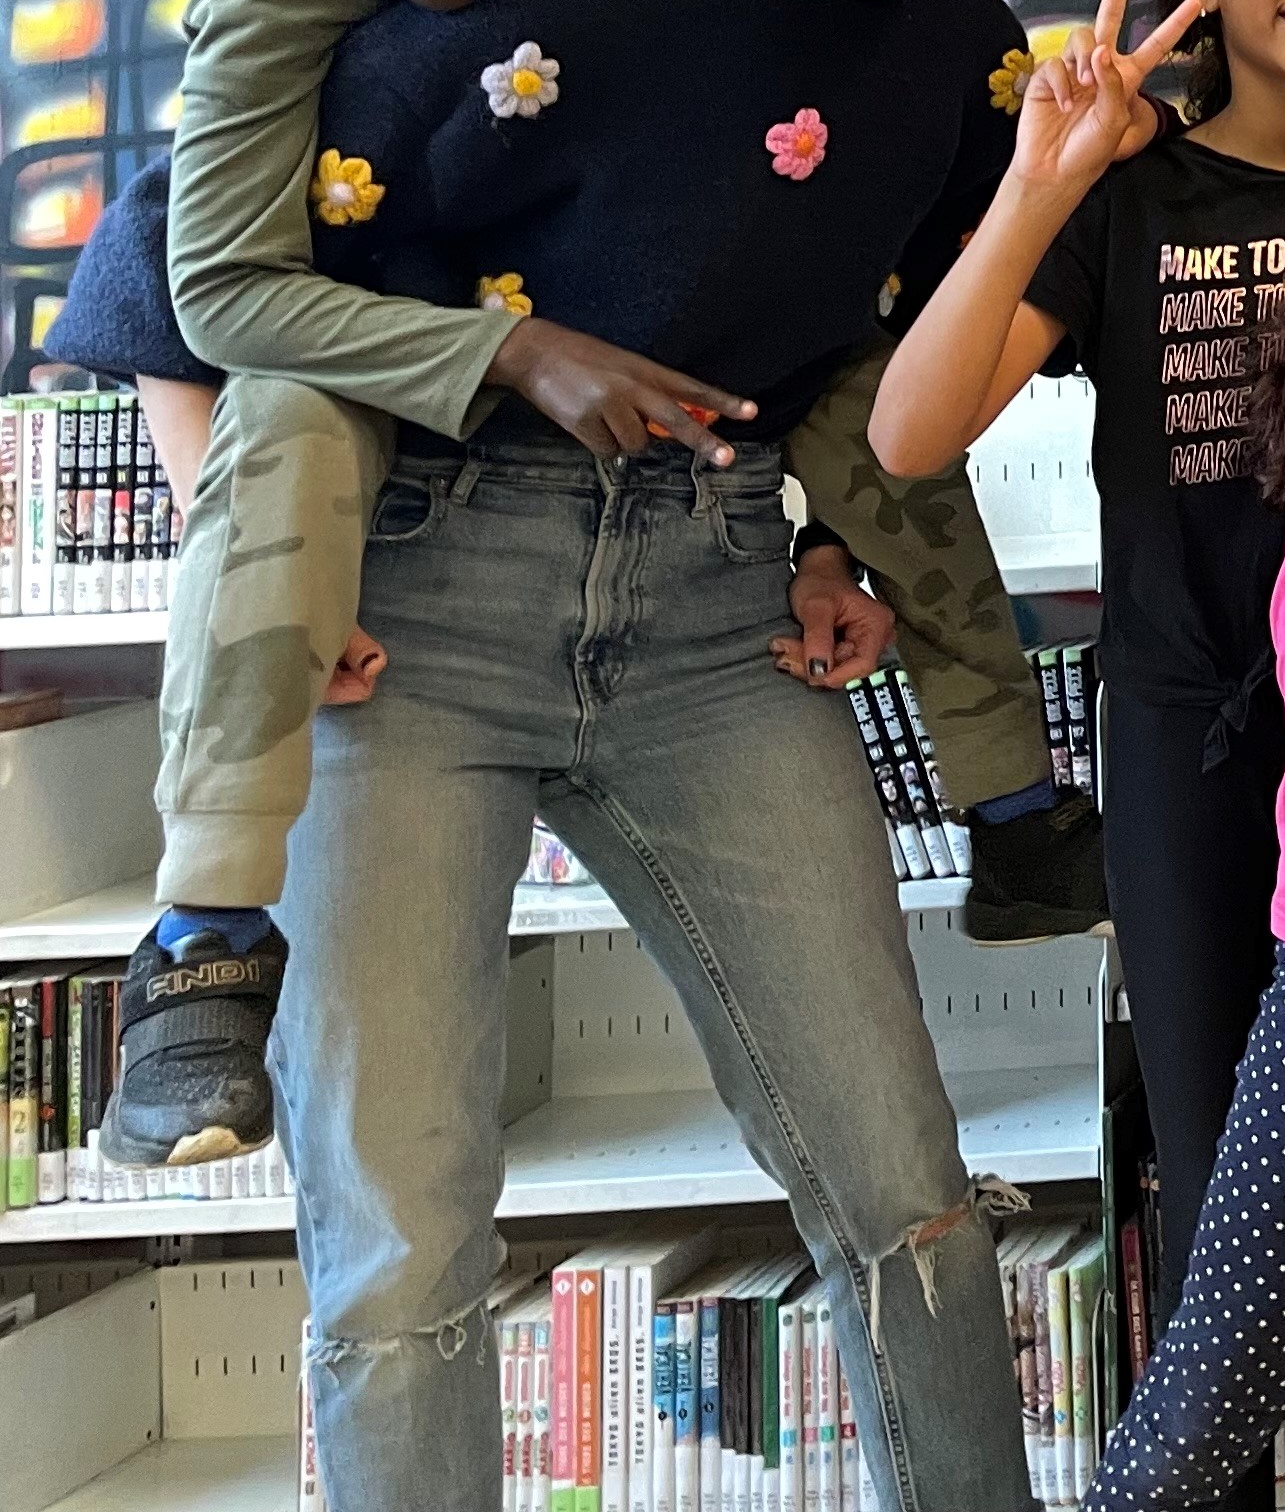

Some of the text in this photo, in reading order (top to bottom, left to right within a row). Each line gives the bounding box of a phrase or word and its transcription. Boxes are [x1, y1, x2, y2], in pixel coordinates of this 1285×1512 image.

[1159, 244, 1240, 284] MAKE
[1159, 287, 1247, 334] MAKE
[1162, 337, 1250, 384] MAKE
[1165, 387, 1252, 435] MAKE
